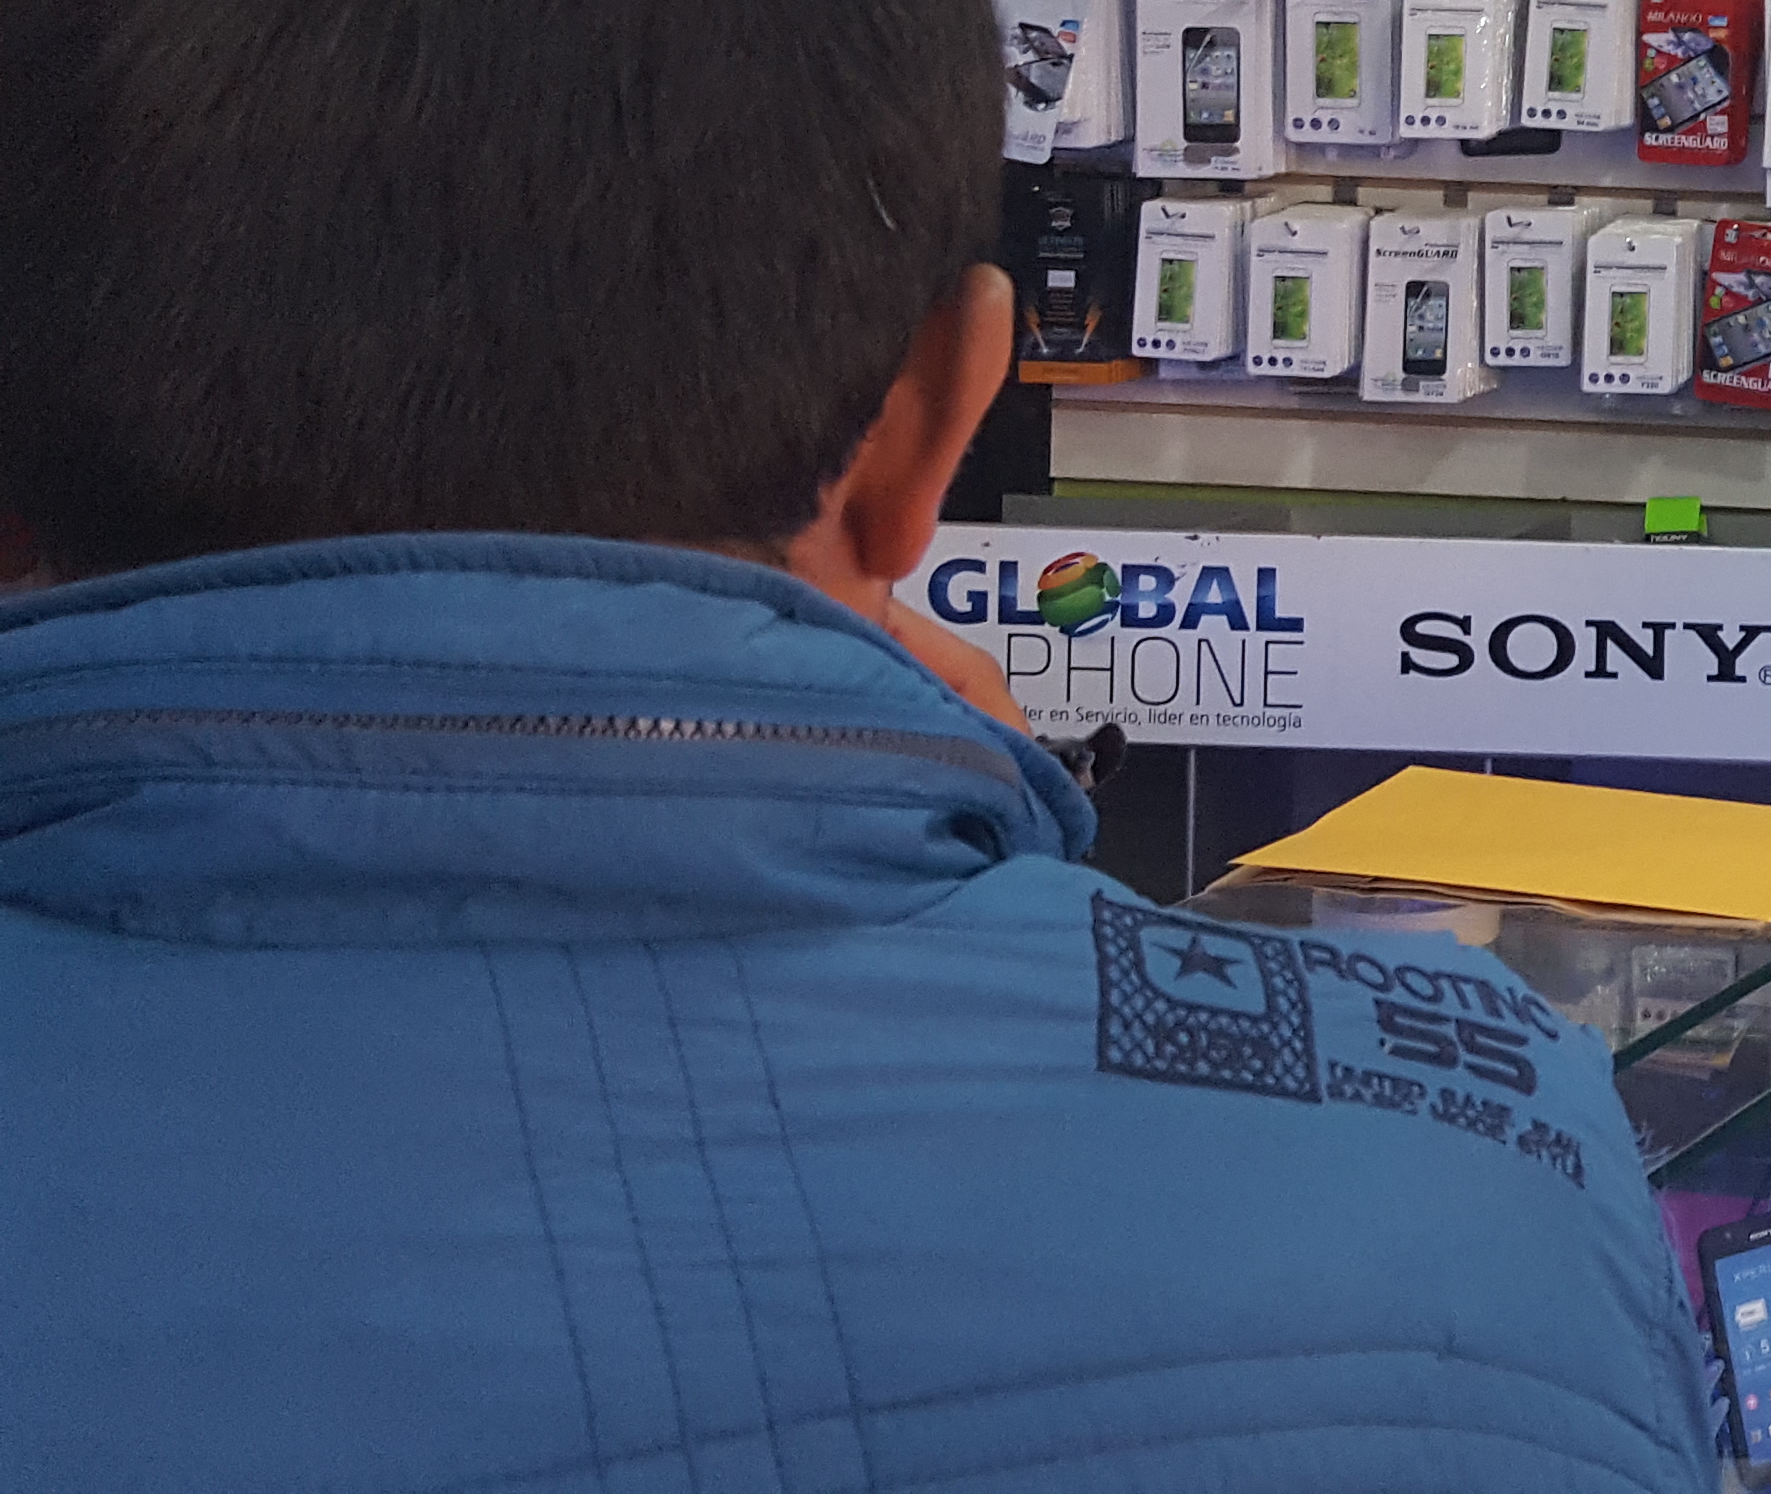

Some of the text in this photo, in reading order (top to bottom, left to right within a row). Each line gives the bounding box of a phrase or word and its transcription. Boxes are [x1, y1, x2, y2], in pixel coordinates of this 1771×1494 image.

[1643, 131, 1730, 152] SCREENGUARD
[928, 557, 1306, 636] GLOBAL
[1006, 634, 1307, 711] PHONE
[1050, 708, 1070, 722] en
[1074, 704, 1143, 727] Servicio,
[1188, 712, 1210, 725] en
[1214, 709, 1303, 732] tecnología
